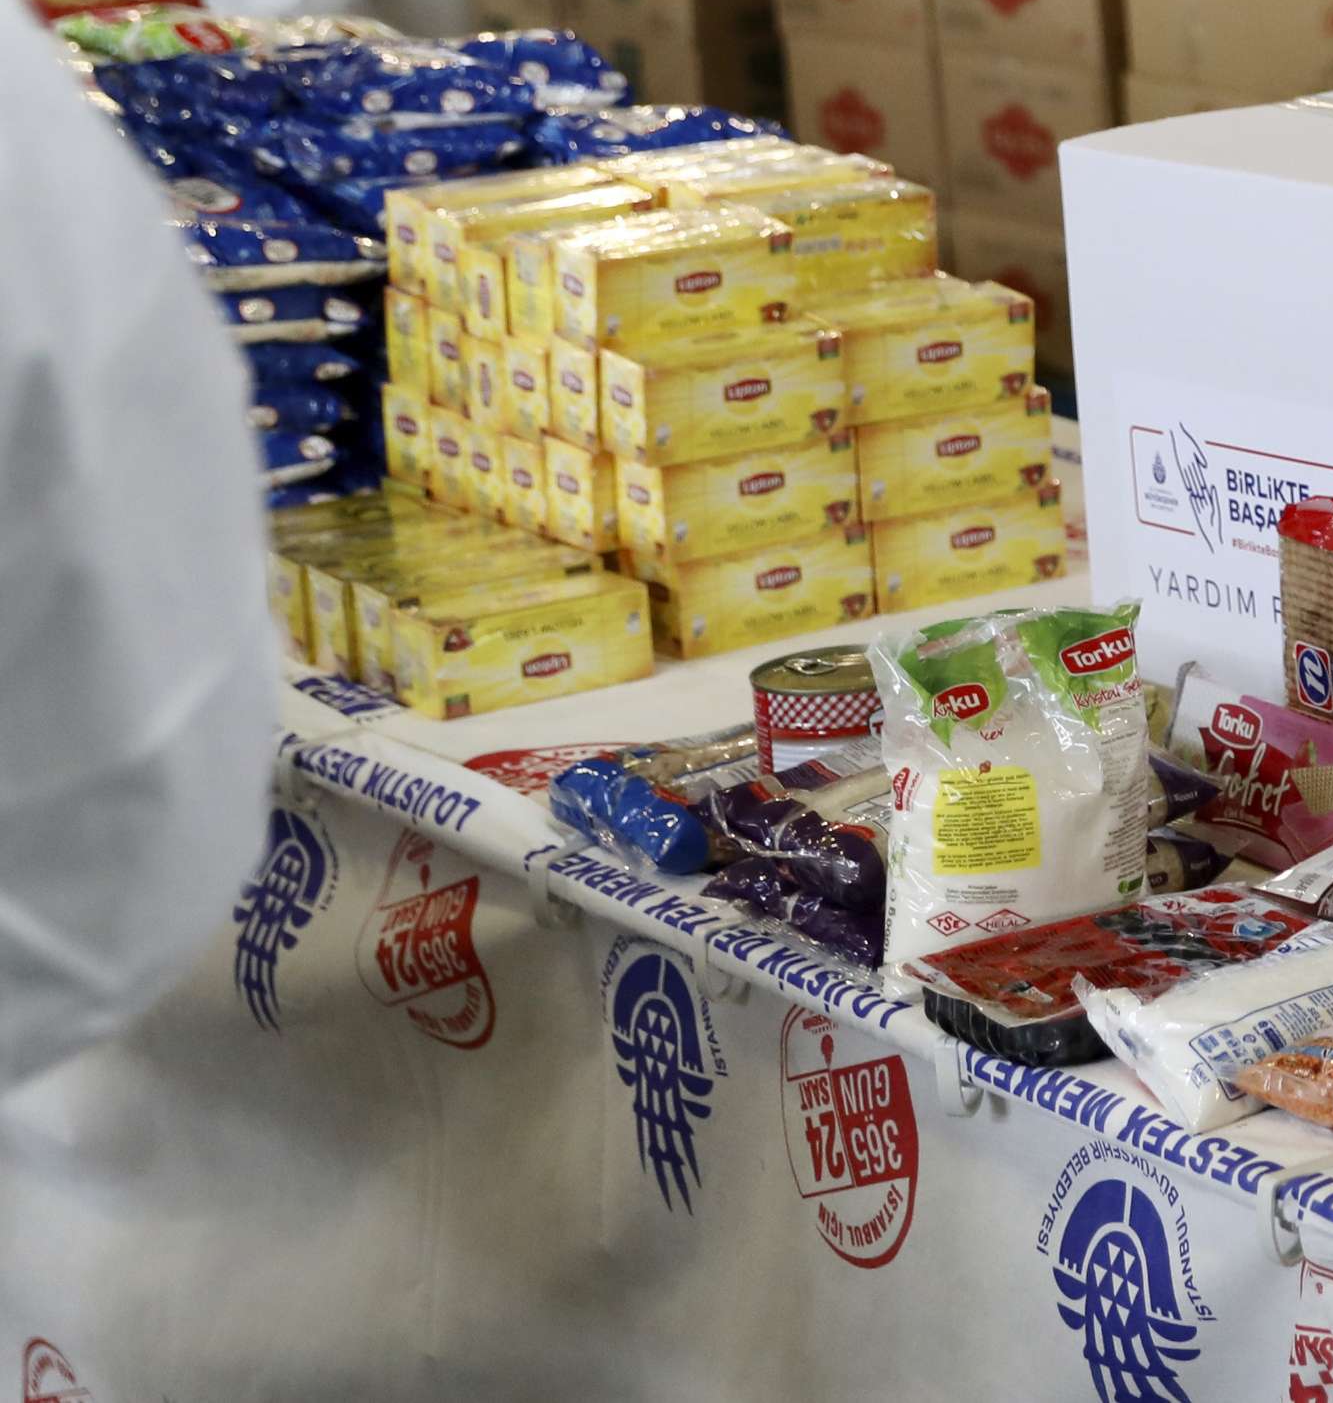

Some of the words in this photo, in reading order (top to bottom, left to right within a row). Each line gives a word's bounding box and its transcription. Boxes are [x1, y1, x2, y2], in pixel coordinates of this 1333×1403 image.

[1229, 498, 1285, 533] BAŞA
[1150, 564, 1257, 618] YARDIM
[1067, 637, 1132, 668] Torku
[1217, 711, 1255, 741] Torku
[800, 1075, 829, 1111] SAAT
[838, 1062, 892, 1124] GÜN
[804, 1110, 846, 1183] 24
[850, 1119, 903, 1177] 365
[1175, 1204, 1217, 1322] İSTANBUL
